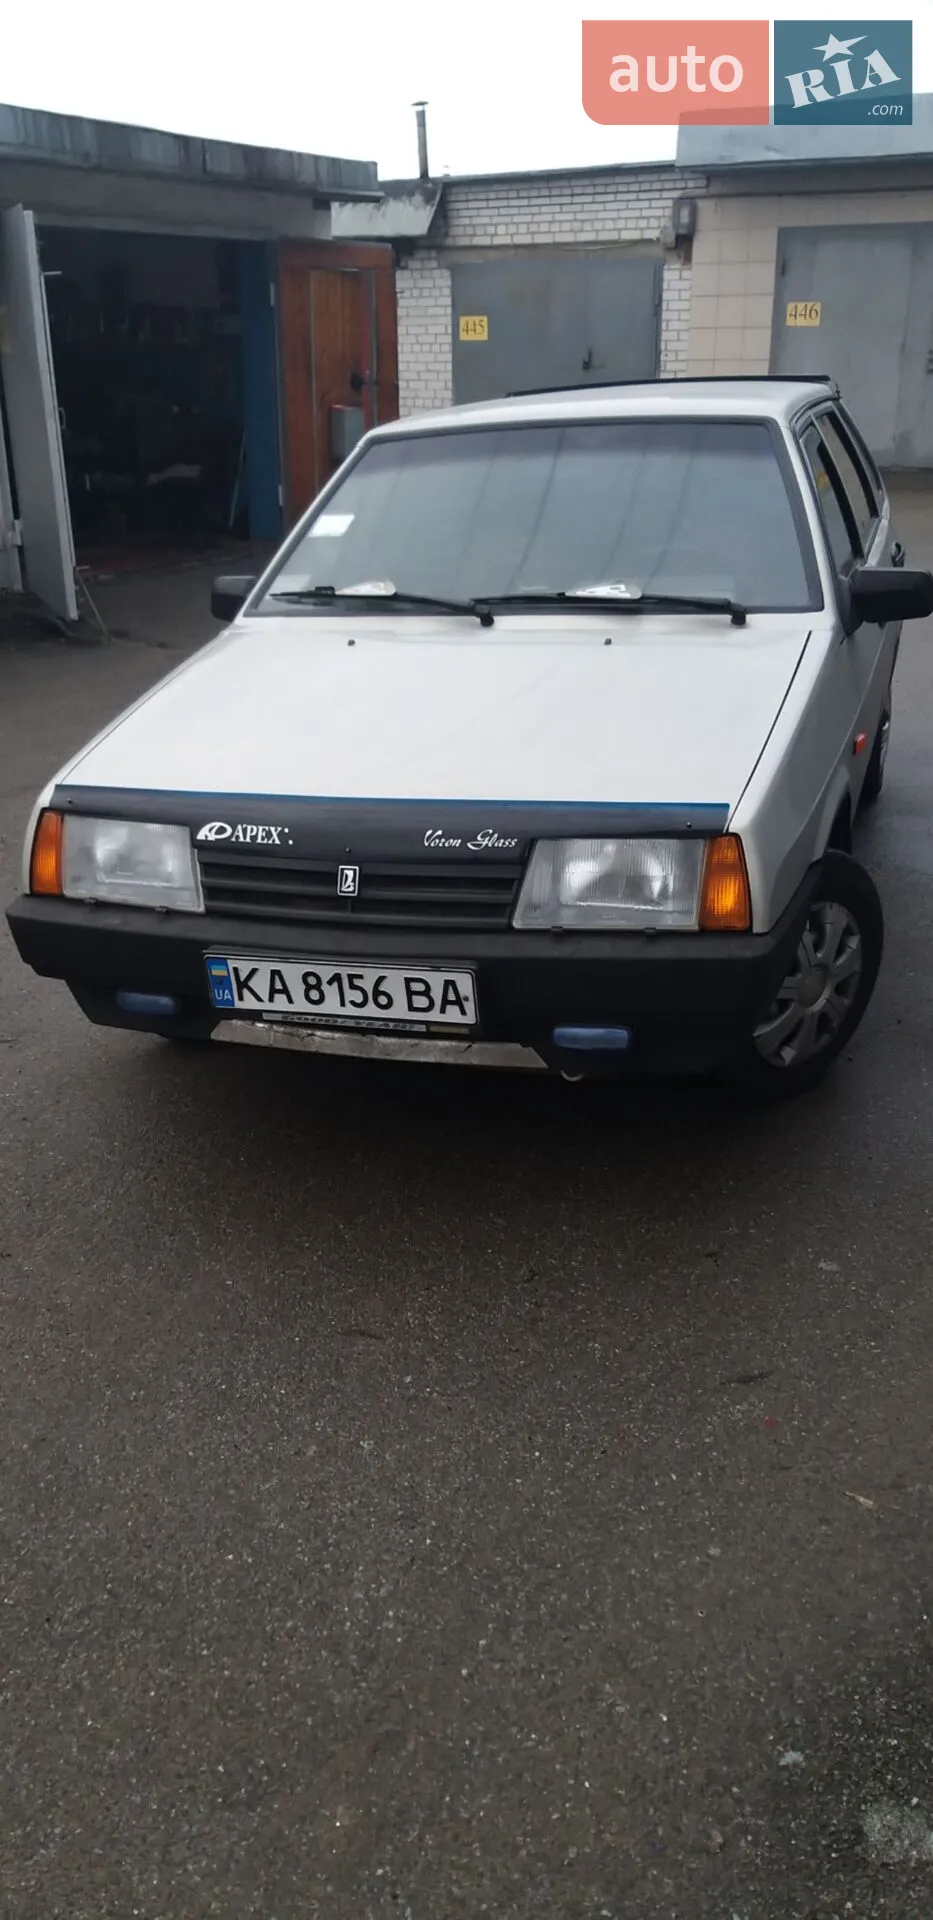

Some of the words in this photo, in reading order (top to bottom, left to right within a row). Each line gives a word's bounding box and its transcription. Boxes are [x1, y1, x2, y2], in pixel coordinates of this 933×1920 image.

[788, 303, 819, 320] 446
[462, 319, 485, 336] 445
[467, 829, 518, 851] Glass
[214, 988, 232, 1001] UA
[232, 966, 294, 1004] KA
[301, 970, 393, 1011] 8156
[403, 976, 468, 1016] BA
